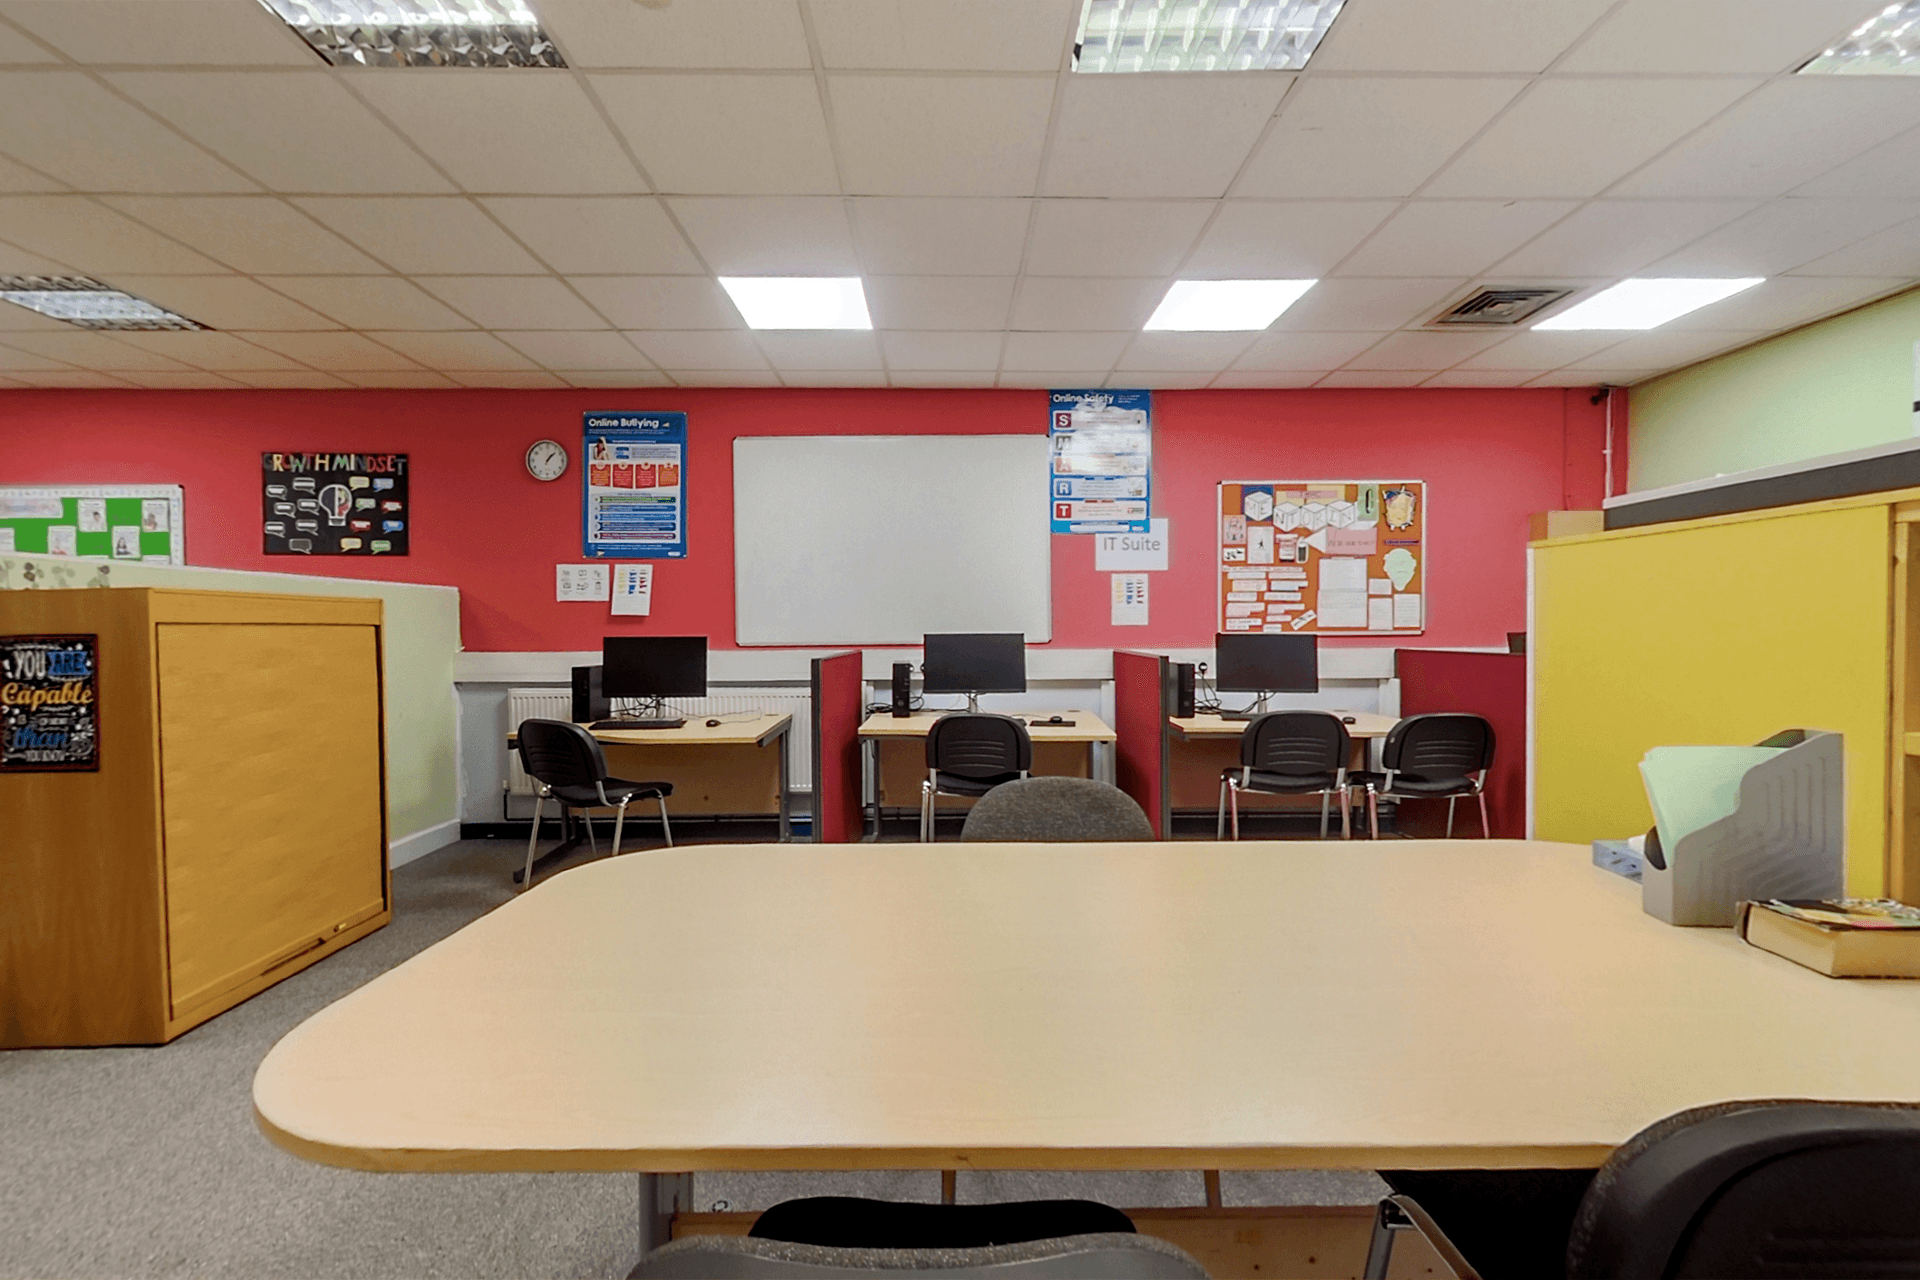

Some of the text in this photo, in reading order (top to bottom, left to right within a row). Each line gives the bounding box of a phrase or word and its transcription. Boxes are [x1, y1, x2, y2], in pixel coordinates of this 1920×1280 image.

[1053, 393, 1083, 402] Online
[1083, 393, 1114, 404] Safety
[588, 418, 659, 428] Online Bullying
[1059, 415, 1068, 426] S
[263, 452, 407, 475] GROWTH MINDSET
[1060, 482, 1069, 494] R
[1059, 505, 1069, 516] T
[1103, 536, 1161, 551] IT Suite
[13, 650, 85, 680] YOU ARE
[1, 681, 94, 712] Capable
[14, 724, 69, 749] than
